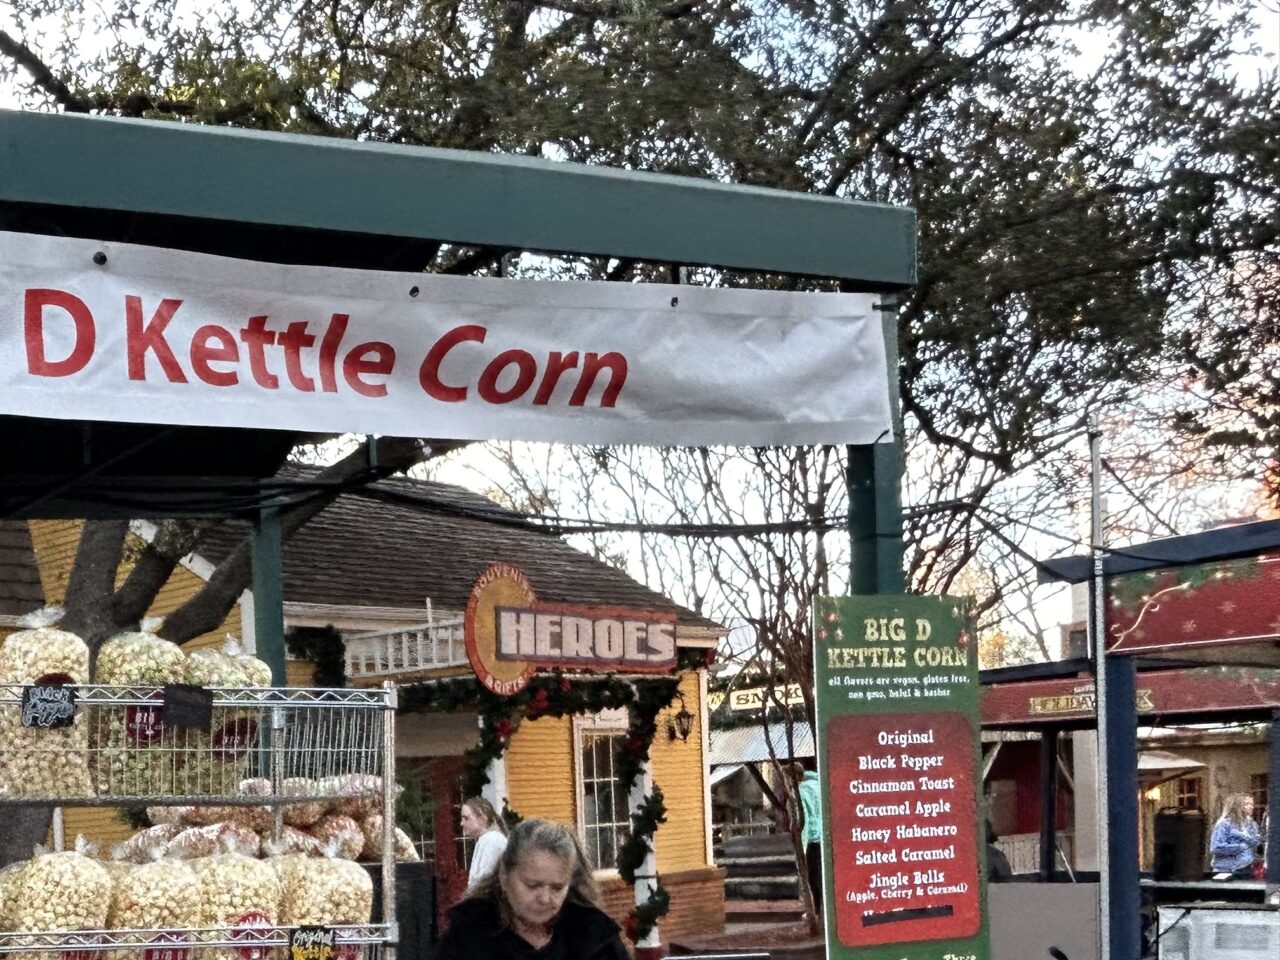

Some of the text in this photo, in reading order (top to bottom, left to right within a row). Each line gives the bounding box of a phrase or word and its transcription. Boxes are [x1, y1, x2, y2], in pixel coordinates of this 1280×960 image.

[24, 288, 95, 377] D
[125, 294, 396, 397] Kettle
[418, 323, 628, 408] Corn
[499, 609, 676, 662] HEROES
[864, 618, 931, 641] BIG D
[828, 647, 968, 668] KETTLE CORN
[878, 730, 934, 747] Original
[858, 755, 944, 770] Black Pepper
[849, 777, 954, 794] Cinnamon Toast
[856, 799, 950, 817] Caramel Apple
[852, 825, 957, 843] Honey Habanero
[856, 846, 955, 865] Salted Caramel
[870, 870, 944, 889] Jingle Bells
[881, 889, 912, 900] Cherry
[916, 887, 923, 896] &
